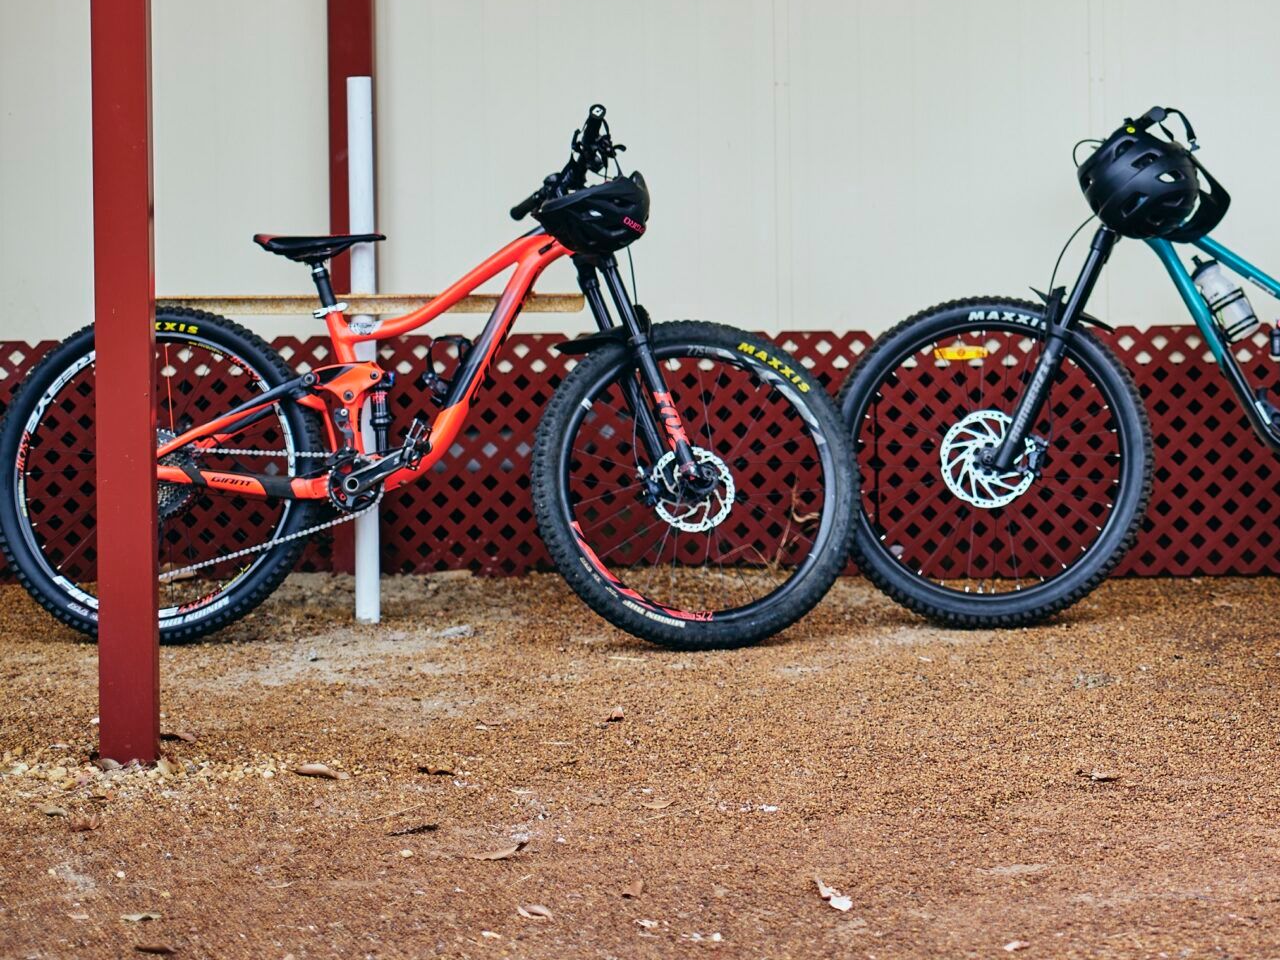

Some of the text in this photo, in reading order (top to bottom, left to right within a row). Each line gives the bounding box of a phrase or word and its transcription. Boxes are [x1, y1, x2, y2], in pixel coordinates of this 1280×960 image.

[737, 342, 811, 393] MAXXIS
[653, 391, 690, 452] FOX
[211, 476, 253, 487] GIANT
